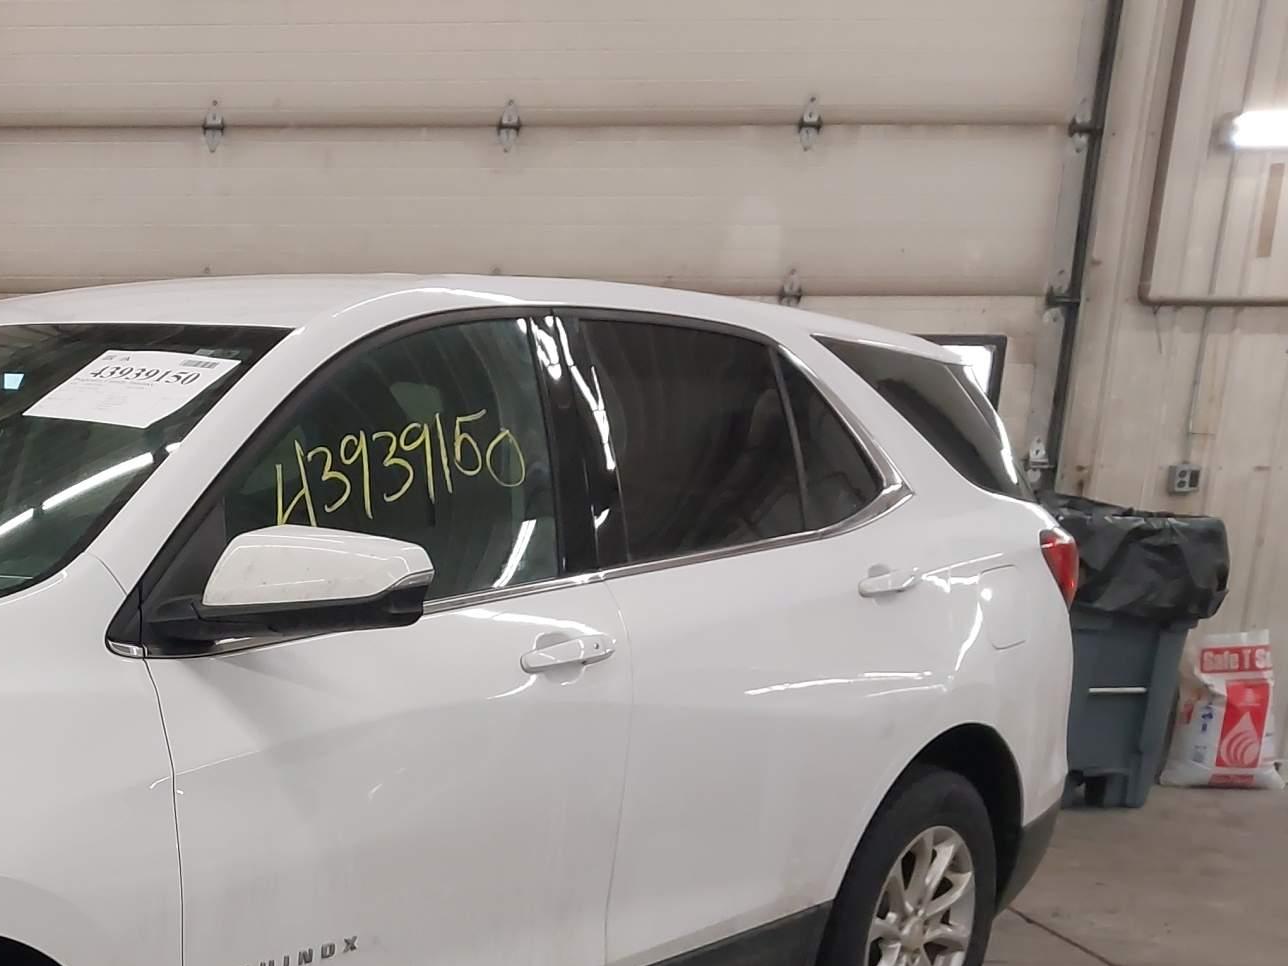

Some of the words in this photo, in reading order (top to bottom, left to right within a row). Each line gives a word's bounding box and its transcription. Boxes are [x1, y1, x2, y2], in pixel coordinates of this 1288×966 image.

[90, 365, 201, 385] 43939150
[275, 409, 526, 527] 43939150
[1242, 648, 1252, 669] T
